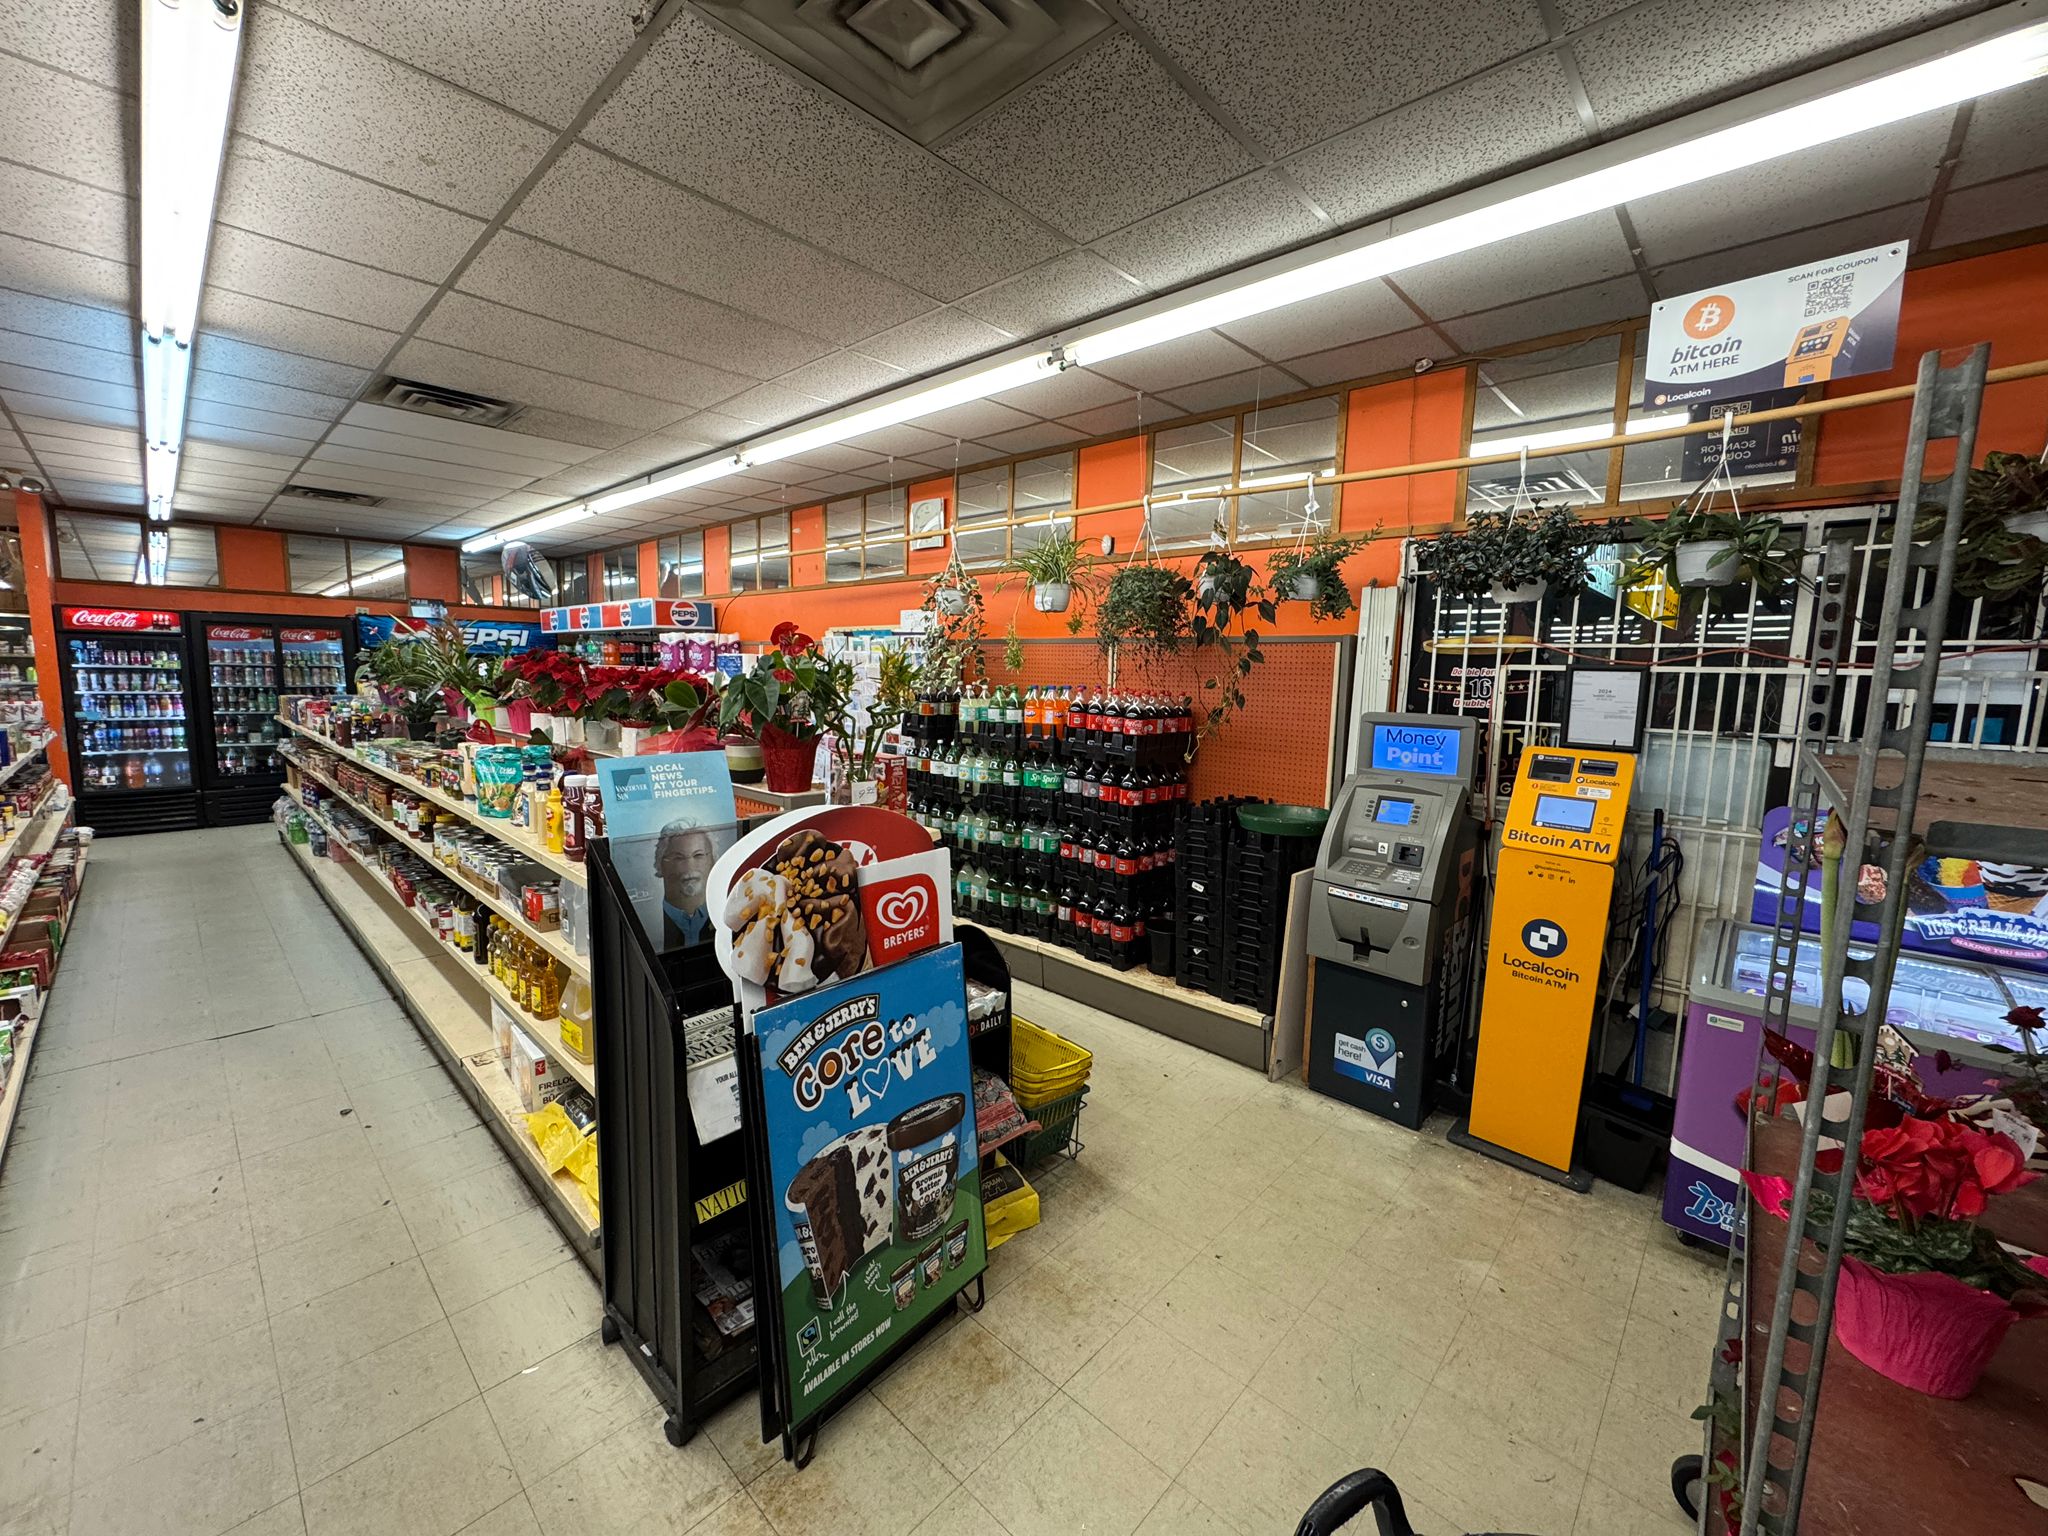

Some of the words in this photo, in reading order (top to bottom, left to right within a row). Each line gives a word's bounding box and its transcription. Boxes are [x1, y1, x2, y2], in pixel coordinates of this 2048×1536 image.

[1788, 268, 1814, 283] SCAN
[1815, 264, 1835, 277] FOR
[1835, 255, 1879, 273] COUPON
[1670, 336, 1743, 365] bitcoin
[1669, 361, 1699, 377] ATM
[1702, 353, 1740, 372] HERE
[1667, 387, 1712, 404] Localcoin
[672, 610, 698, 618] PEPSI
[461, 627, 530, 648] EPSI
[1469, 678, 1492, 699] 16
[1453, 698, 1485, 708] Duble
[1386, 728, 1447, 751] Money
[1387, 746, 1444, 766] Point
[650, 763, 685, 773] LOCAL
[651, 772, 683, 782] NEWS
[615, 783, 648, 793] VANCOUVER
[653, 781, 667, 790] AT
[669, 779, 697, 789] YOUR
[1585, 778, 1620, 787] Localcoin
[655, 786, 717, 799] FINGERTIPS.
[1507, 828, 1566, 849] Bitcoin
[1569, 838, 1611, 855] ATM
[883, 927, 925, 949] BREYERS
[1924, 918, 1954, 936] ICE
[1957, 916, 2021, 941] CREAM
[1955, 940, 1990, 952] MAKING
[1993, 948, 2012, 956] YOU
[1503, 953, 1580, 983] Localcoin
[1512, 970, 1543, 984] Bitcoin
[1545, 979, 1567, 990] ATM
[887, 1013, 916, 1043] to
[980, 1014, 1002, 1032] DAILY
[1338, 1039, 1350, 1048] get
[1350, 1043, 1366, 1052] cash
[1338, 1046, 1362, 1061] here!
[715, 1073, 730, 1085] YOUR
[1365, 1070, 1392, 1089] VISA
[915, 1169, 944, 1189] Brownie
[918, 1179, 941, 1196] Batter
[833, 1309, 845, 1325] call
[846, 1302, 857, 1315] the
[803, 1357, 841, 1397] AVAILABLE
[841, 1350, 850, 1365] IN
[850, 1330, 875, 1358] STORES
[875, 1316, 892, 1338] NOW
